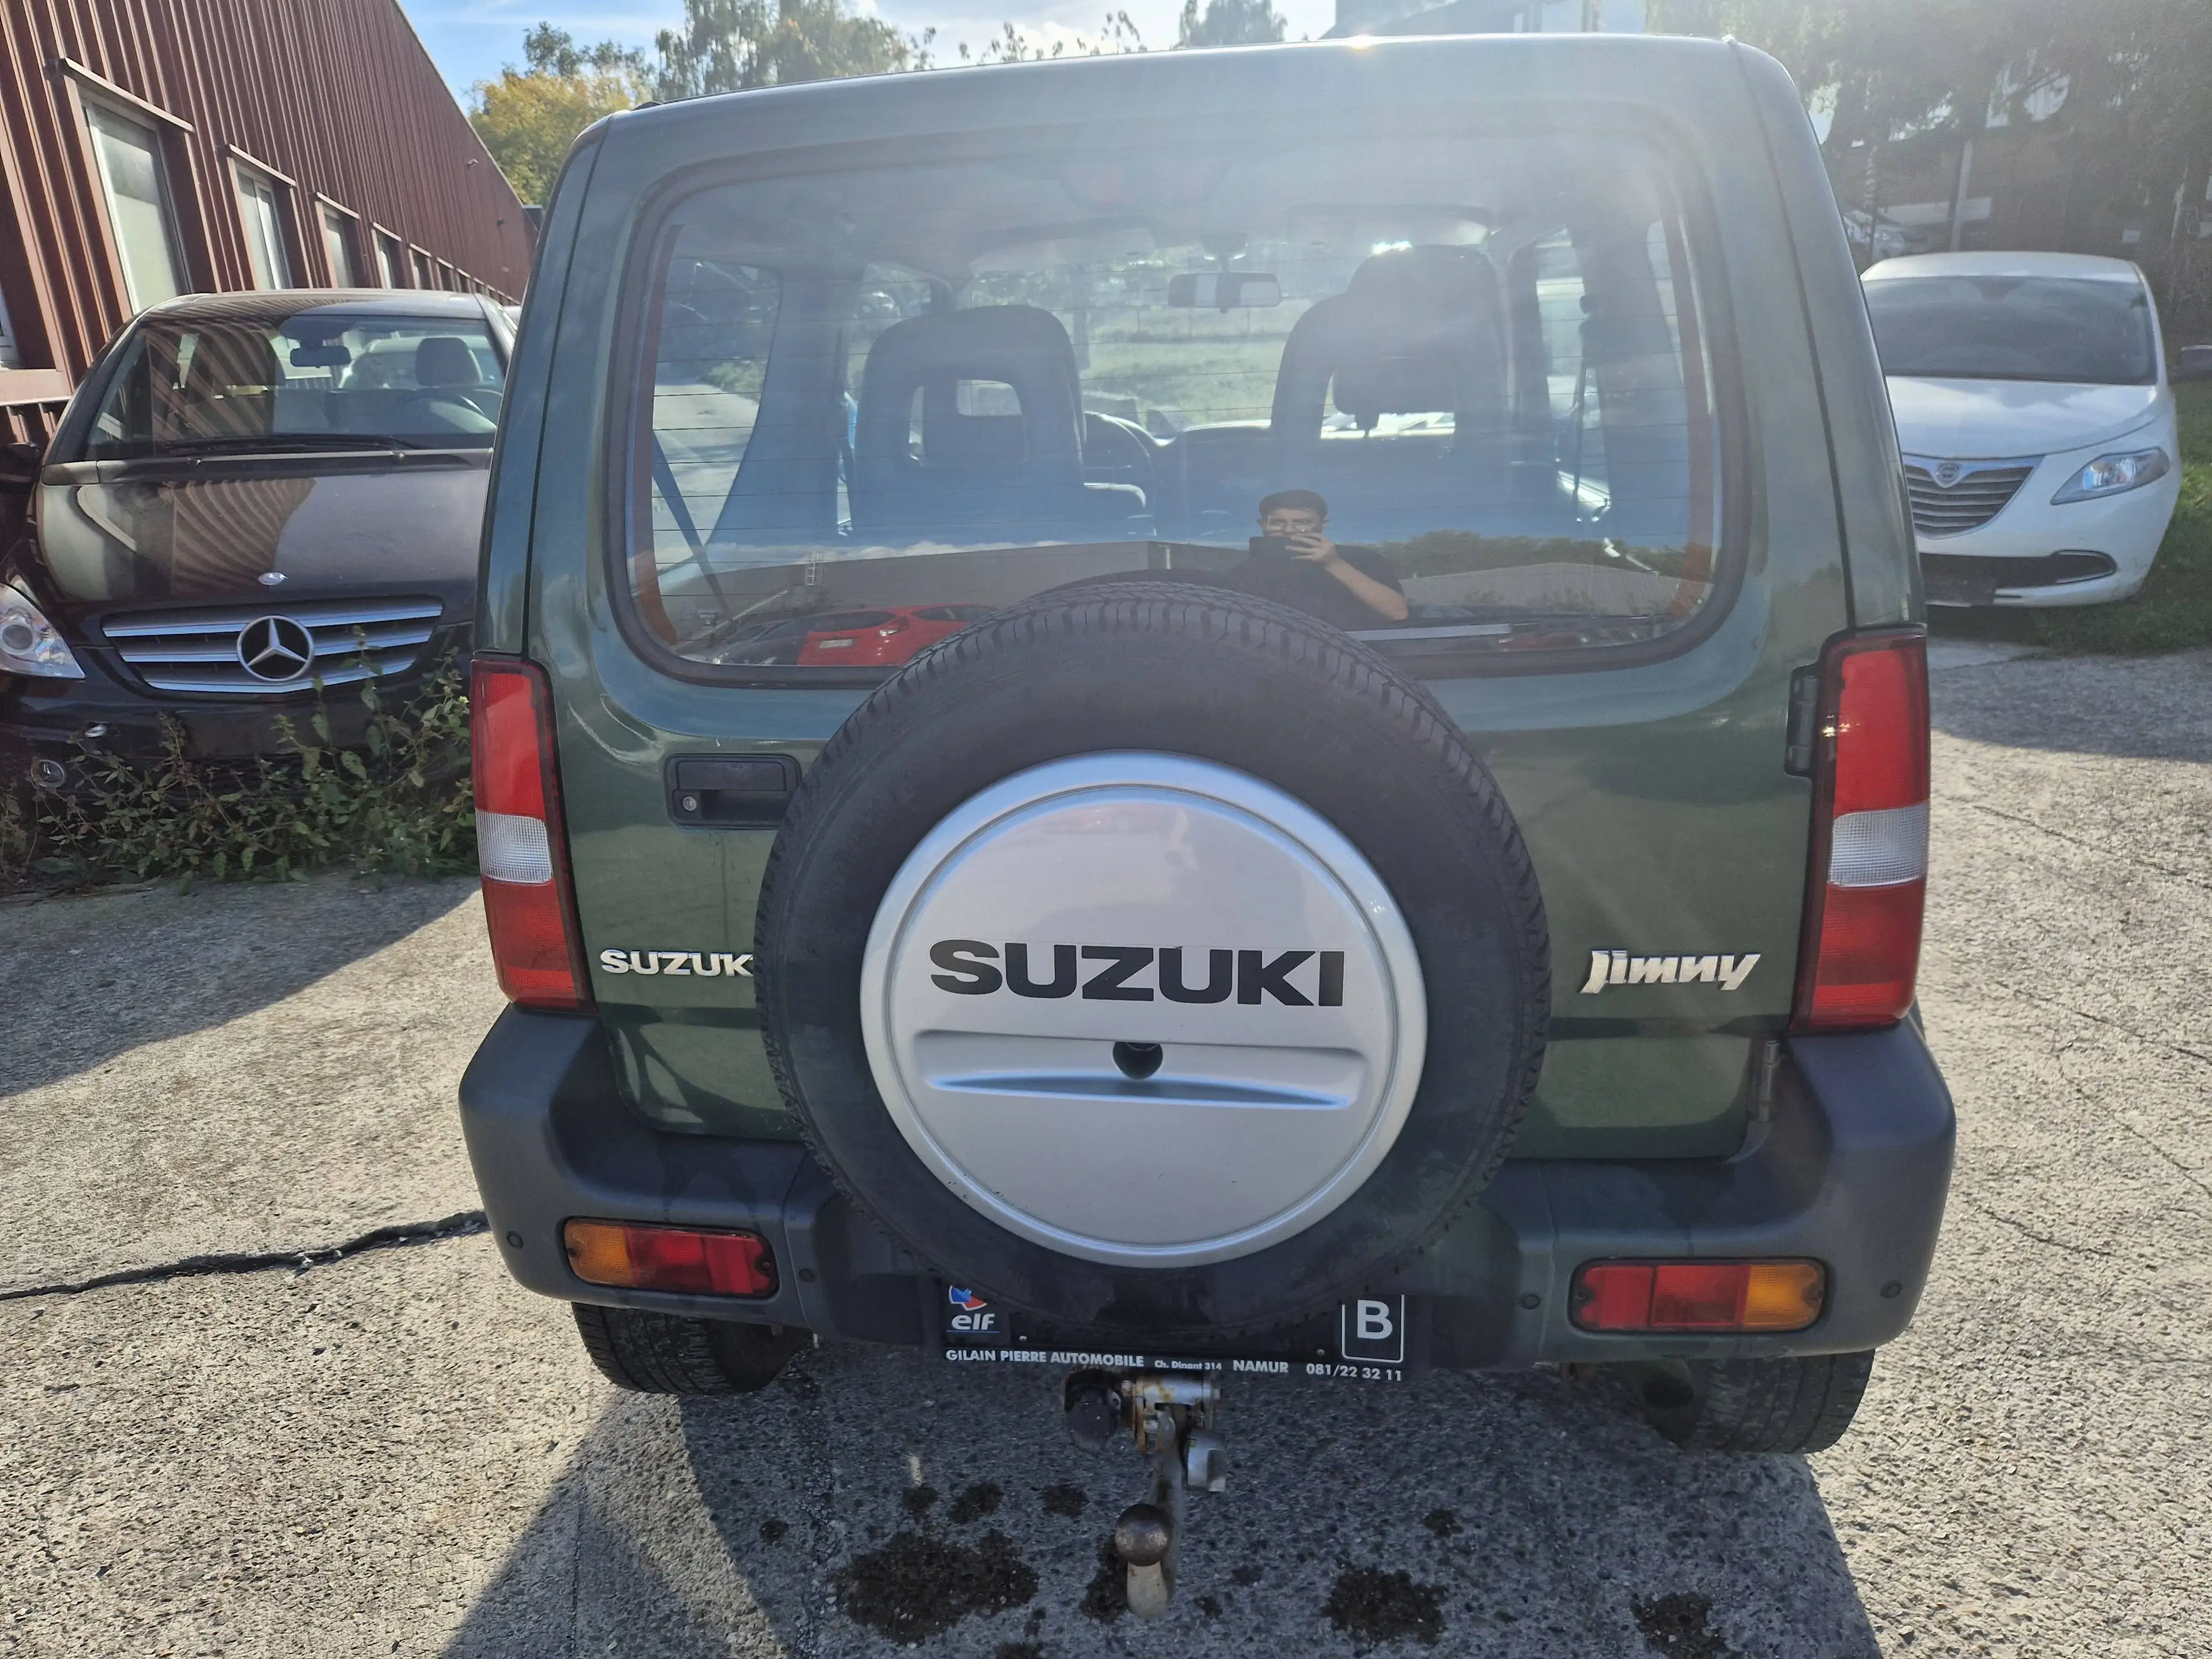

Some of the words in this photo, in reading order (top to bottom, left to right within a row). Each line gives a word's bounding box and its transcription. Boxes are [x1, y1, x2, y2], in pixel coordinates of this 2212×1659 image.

[600, 949, 753, 976] SUZUK
[929, 939, 1344, 1007] SUZUKI
[1580, 950, 1761, 994] Jimny
[952, 1313, 995, 1330] elf
[1357, 1300, 1393, 1339] B
[946, 1350, 996, 1361] GILAIN
[1000, 1350, 1047, 1362] PIERRE
[1050, 1352, 1145, 1367] AUTOMOBILE
[1154, 1360, 1169, 1368] Ch.
[1171, 1361, 1202, 1369] Dinant
[1205, 1362, 1222, 1370] 314
[1233, 1360, 1289, 1373] NAMUR
[1306, 1363, 1357, 1377] 081/22
[1362, 1368, 1381, 1379] 32
[1385, 1369, 1401, 1381] 11
